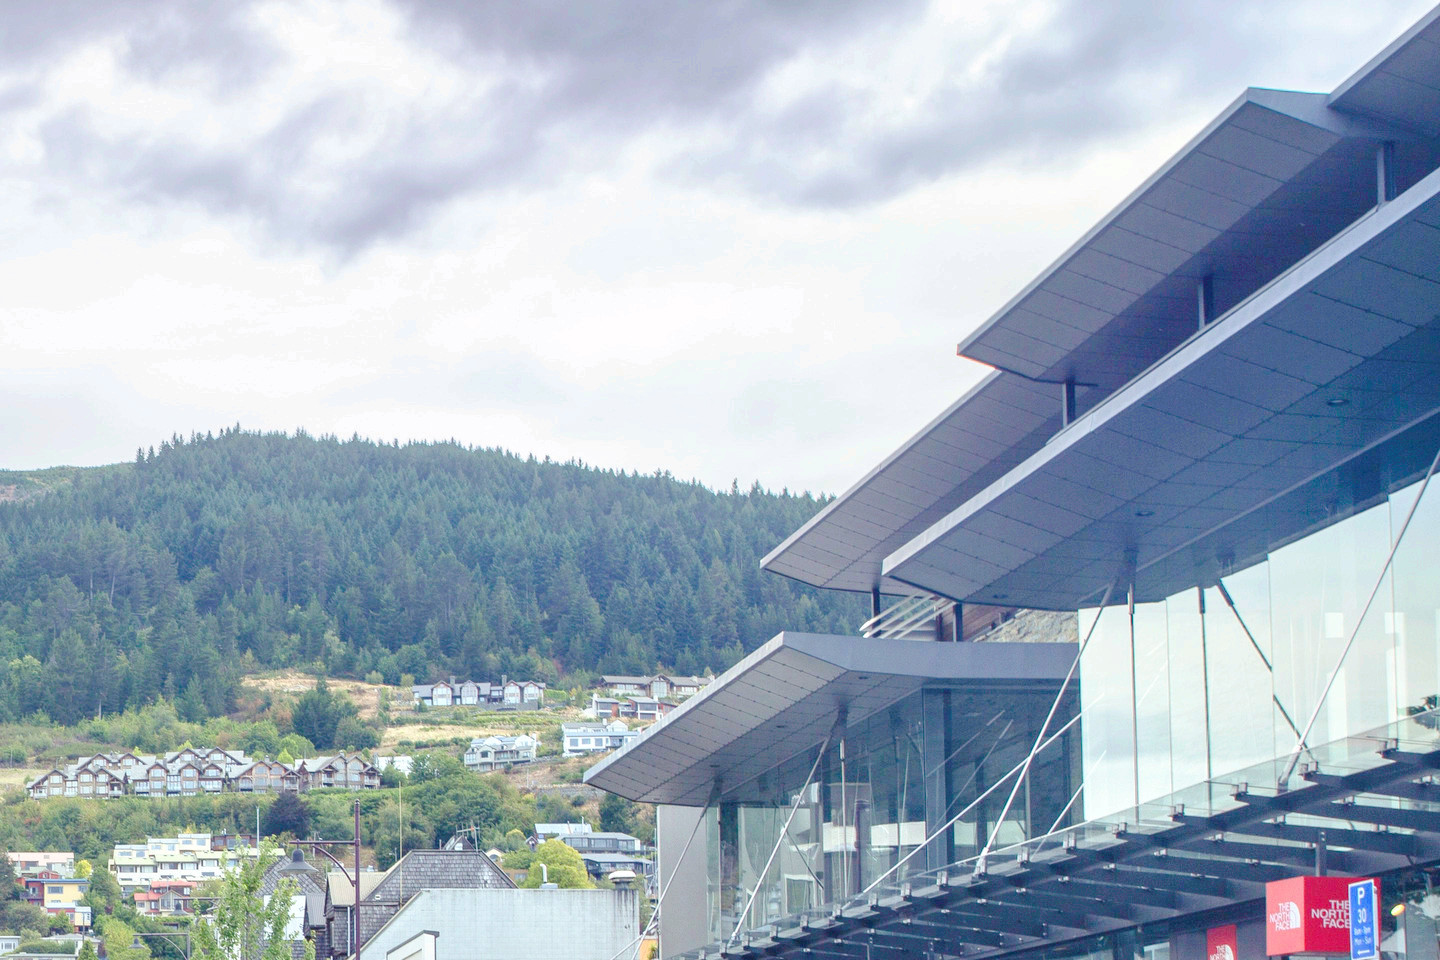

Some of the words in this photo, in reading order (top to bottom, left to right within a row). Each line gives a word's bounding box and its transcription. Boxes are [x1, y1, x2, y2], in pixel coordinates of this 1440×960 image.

[1357, 887, 1365, 900] P
[1278, 902, 1291, 911] THE
[1329, 900, 1350, 910] THE
[1269, 912, 1291, 922] NORTH
[1311, 909, 1350, 919] NORTH
[1357, 908, 1367, 924] 30
[1275, 921, 1291, 931] FACE
[1323, 918, 1351, 928] FACE
[1216, 945, 1226, 953] THE
